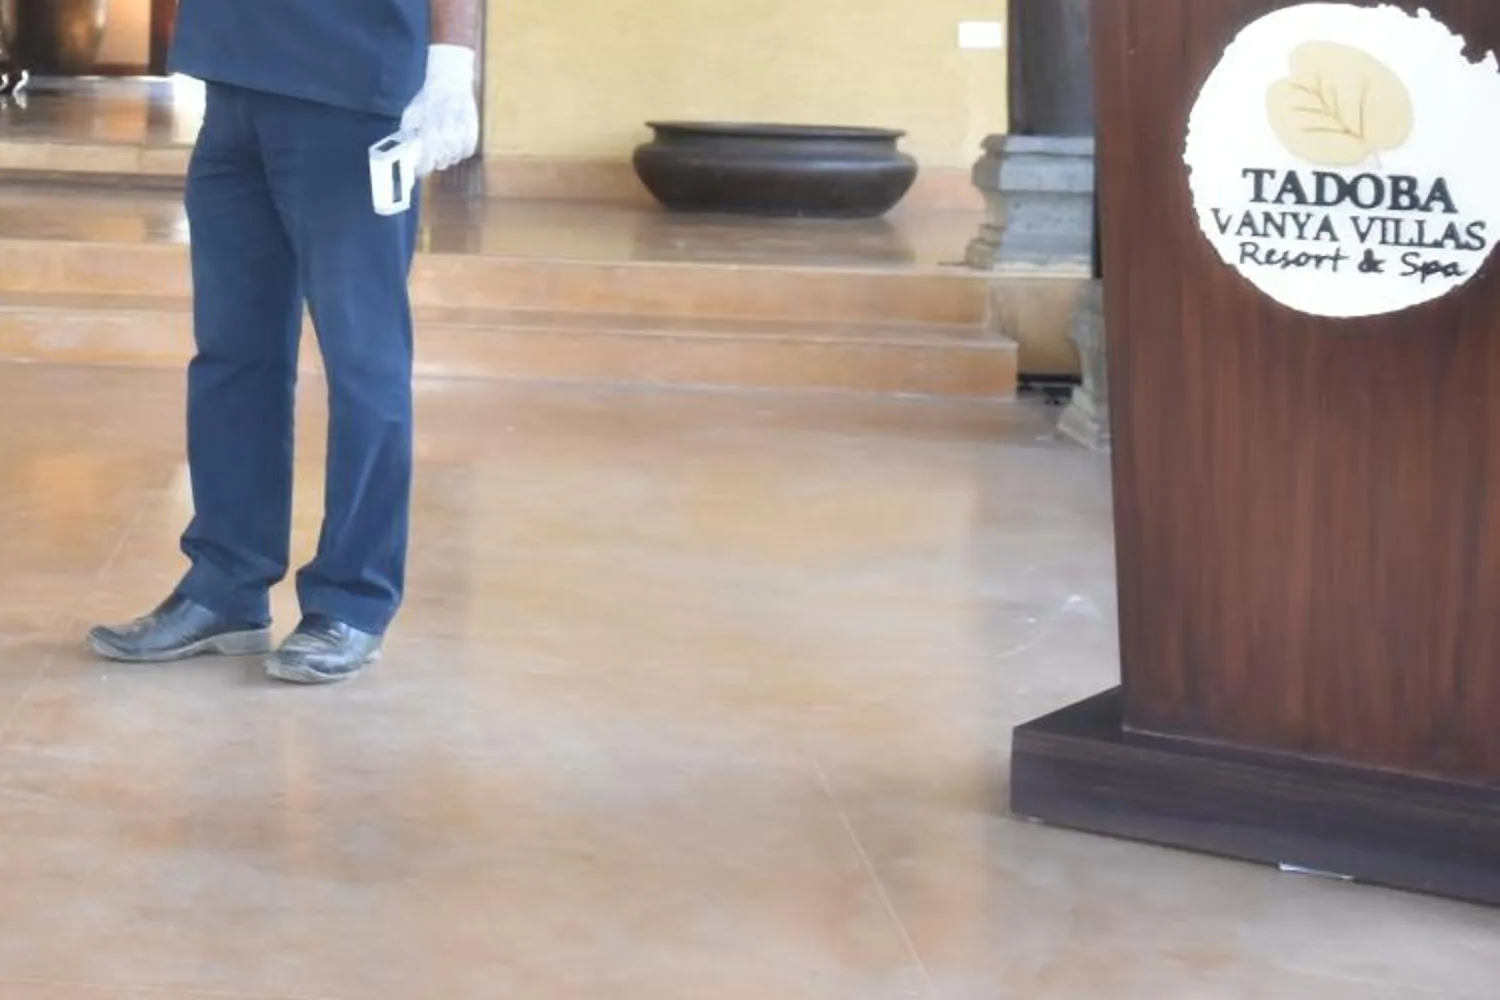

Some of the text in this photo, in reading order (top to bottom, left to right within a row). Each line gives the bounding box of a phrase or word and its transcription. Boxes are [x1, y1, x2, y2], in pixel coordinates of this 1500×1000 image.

[1242, 168, 1458, 213] TADOBA
[1211, 208, 1487, 251] VANYA VILLAS
[1238, 242, 1467, 283] Resort & Spa
